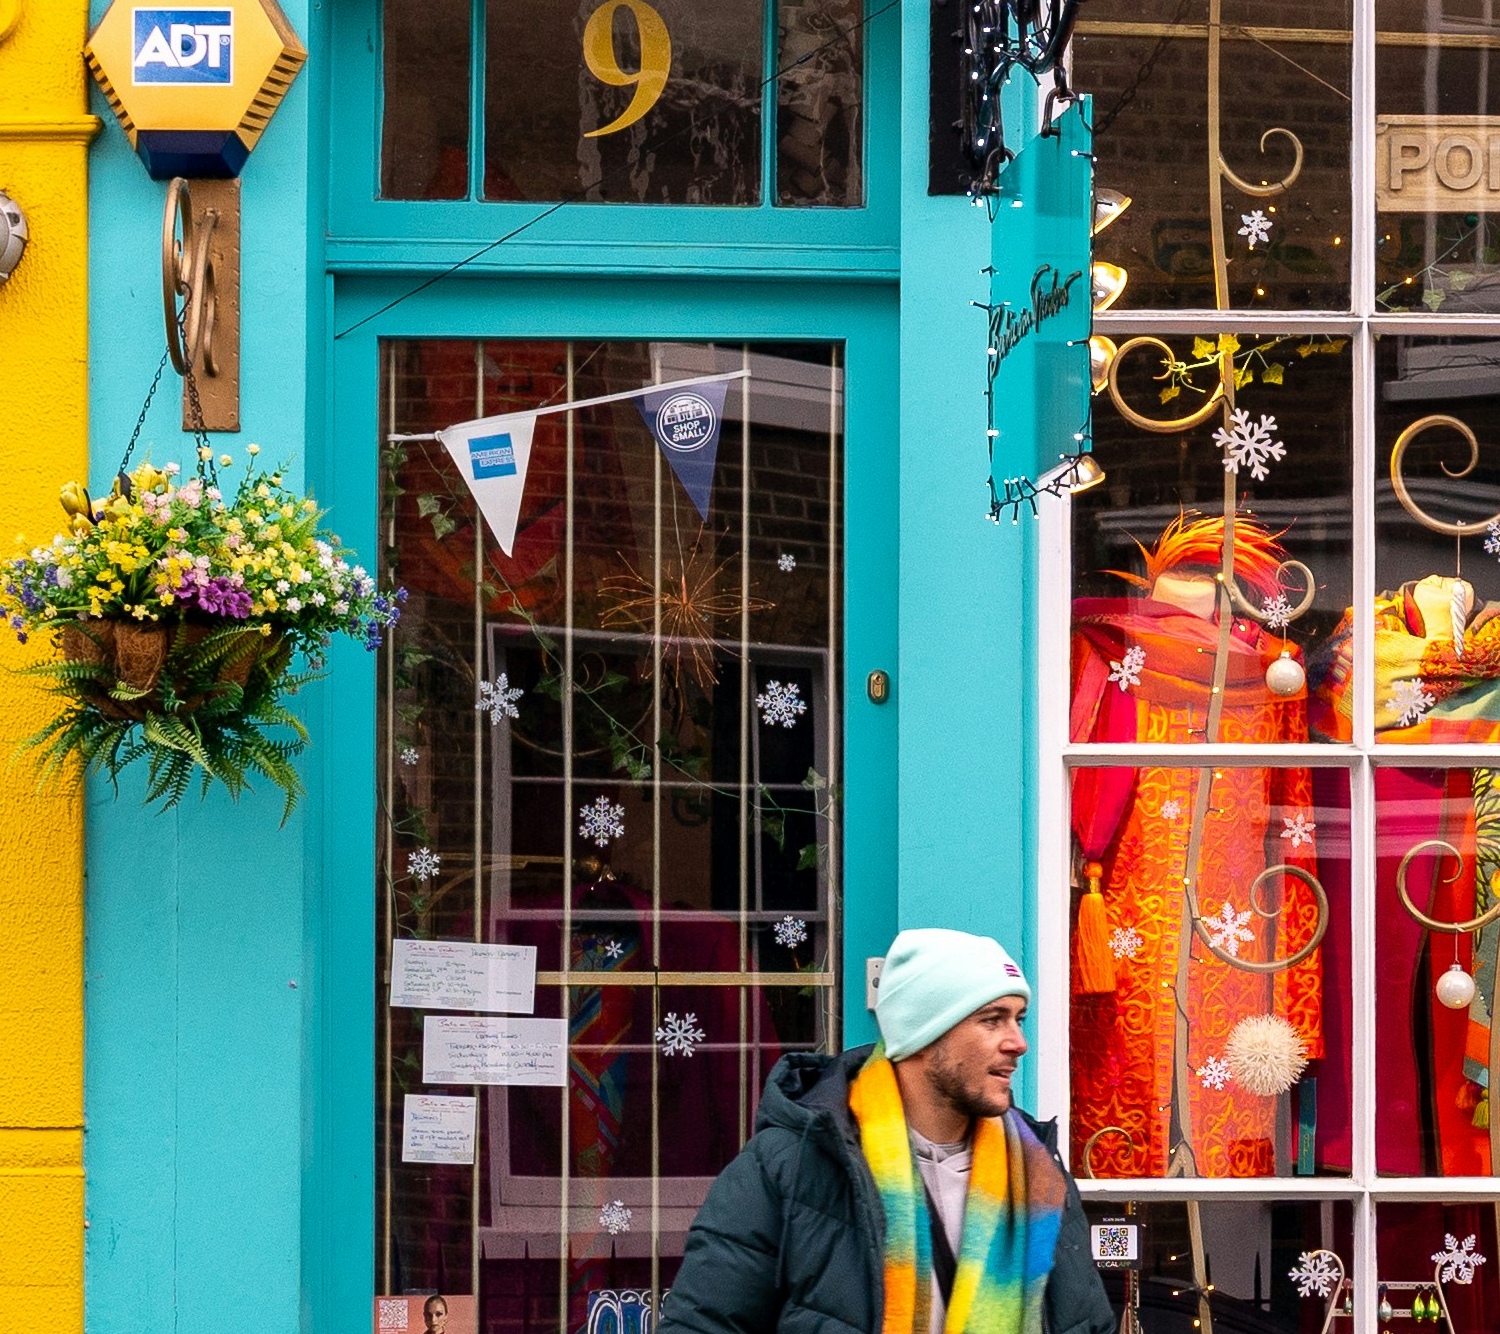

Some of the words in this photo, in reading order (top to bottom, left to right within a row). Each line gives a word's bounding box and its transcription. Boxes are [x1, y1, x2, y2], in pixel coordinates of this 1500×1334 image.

[134, 23, 233, 68] ADT
[673, 420, 700, 434] SHOP
[672, 429, 705, 443] SMALL
[470, 447, 512, 459] AMERICAN
[480, 456, 516, 467] EXPRESS
